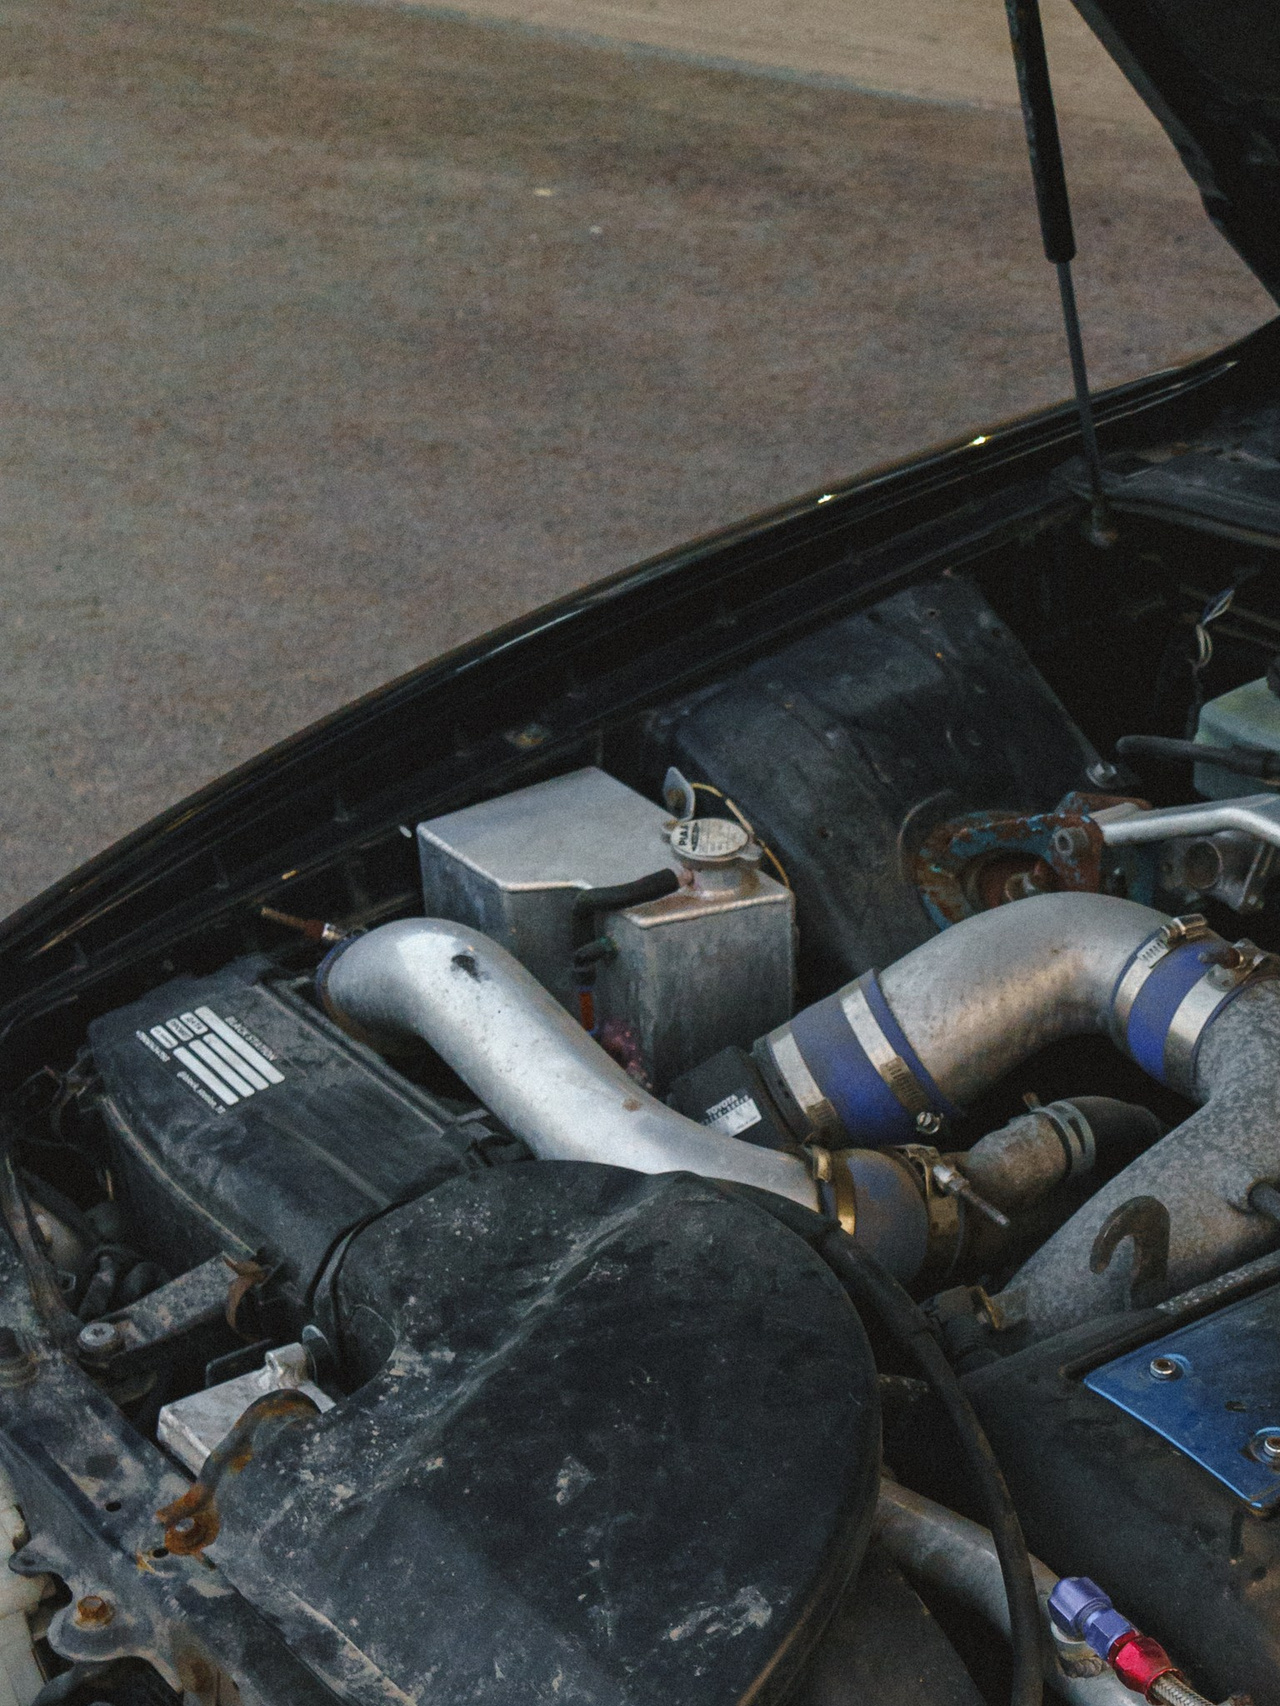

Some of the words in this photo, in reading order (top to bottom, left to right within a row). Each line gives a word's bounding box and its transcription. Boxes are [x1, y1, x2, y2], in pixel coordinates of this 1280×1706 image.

[224, 1015, 251, 1042] BLACK
[244, 1033, 278, 1061] STATION
[704, 1092, 739, 1117] TOYOTA
